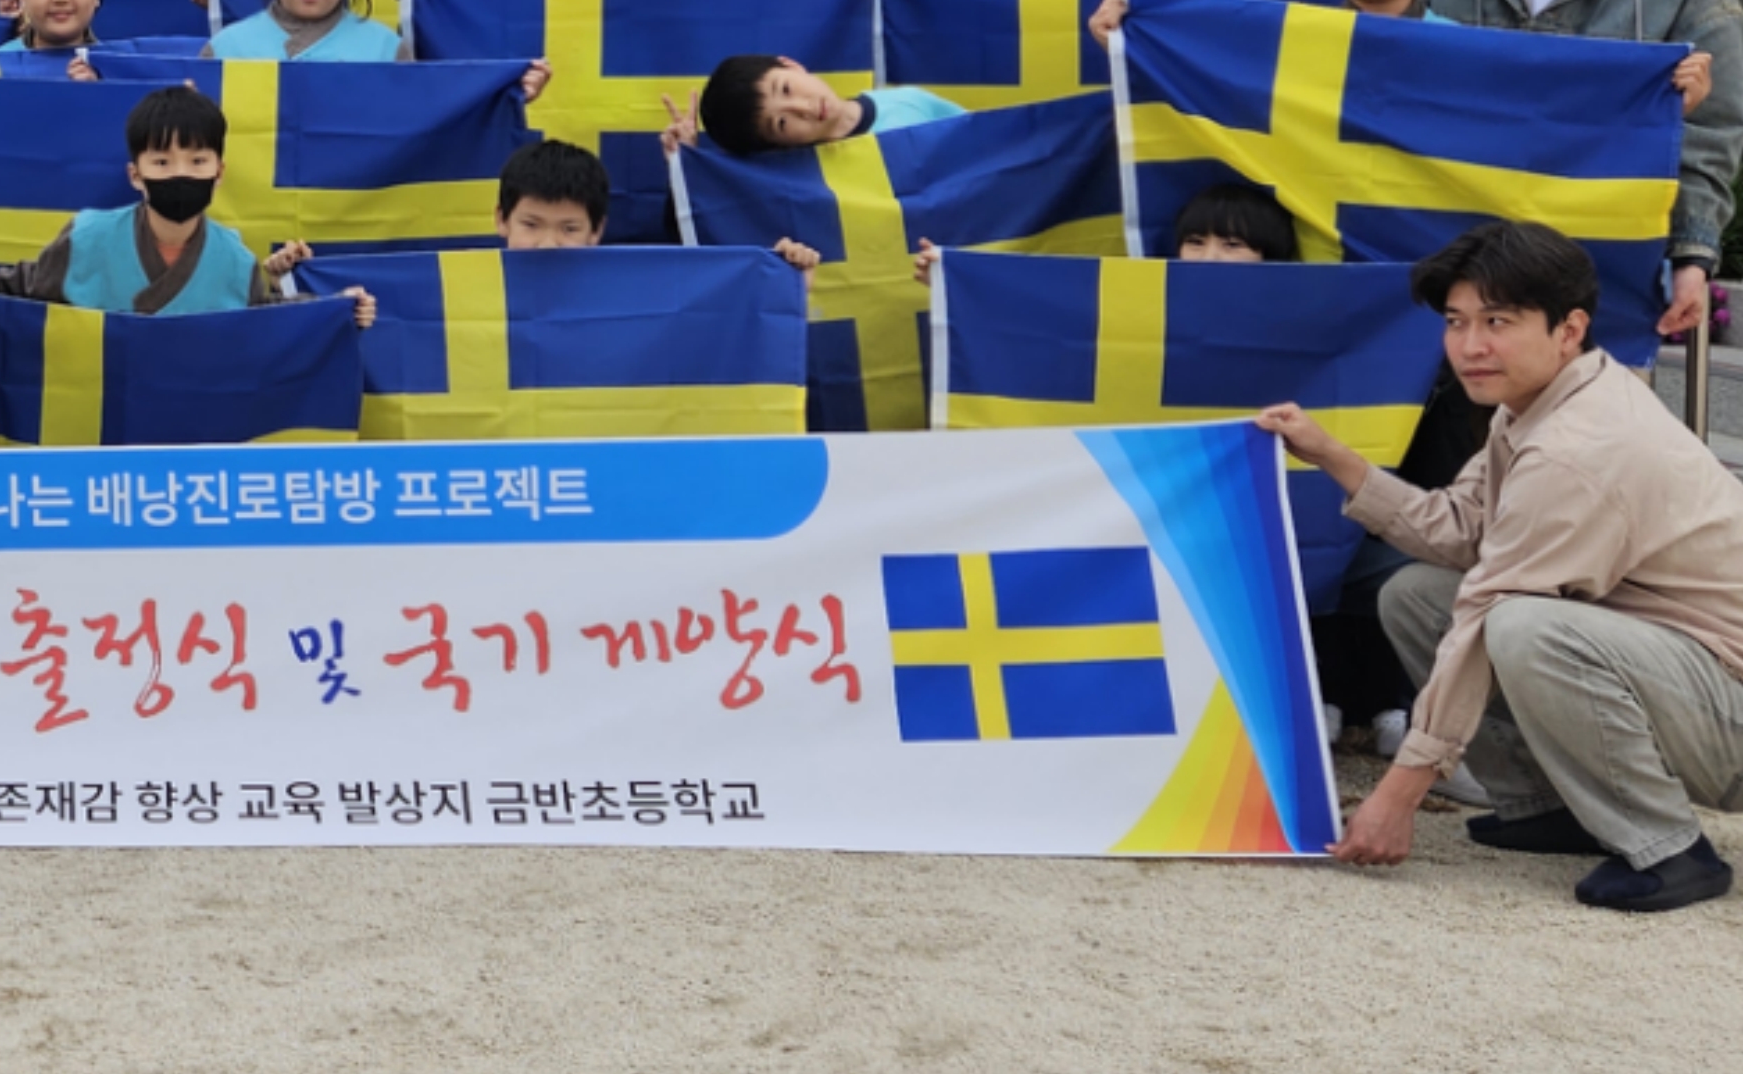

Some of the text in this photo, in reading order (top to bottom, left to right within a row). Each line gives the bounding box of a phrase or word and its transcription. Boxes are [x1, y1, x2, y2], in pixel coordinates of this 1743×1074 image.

[87, 469, 381, 526] 배낭진로탐방
[394, 467, 593, 523] 프로젝트
[0, 589, 258, 732] 출정식
[288, 619, 361, 704] 및
[384, 604, 550, 713] 국기
[582, 588, 862, 711] 게양식
[134, 779, 224, 823] 향상
[238, 780, 325, 825] 교육
[337, 779, 473, 825] 발상지
[486, 777, 766, 826] 금반초등학교
